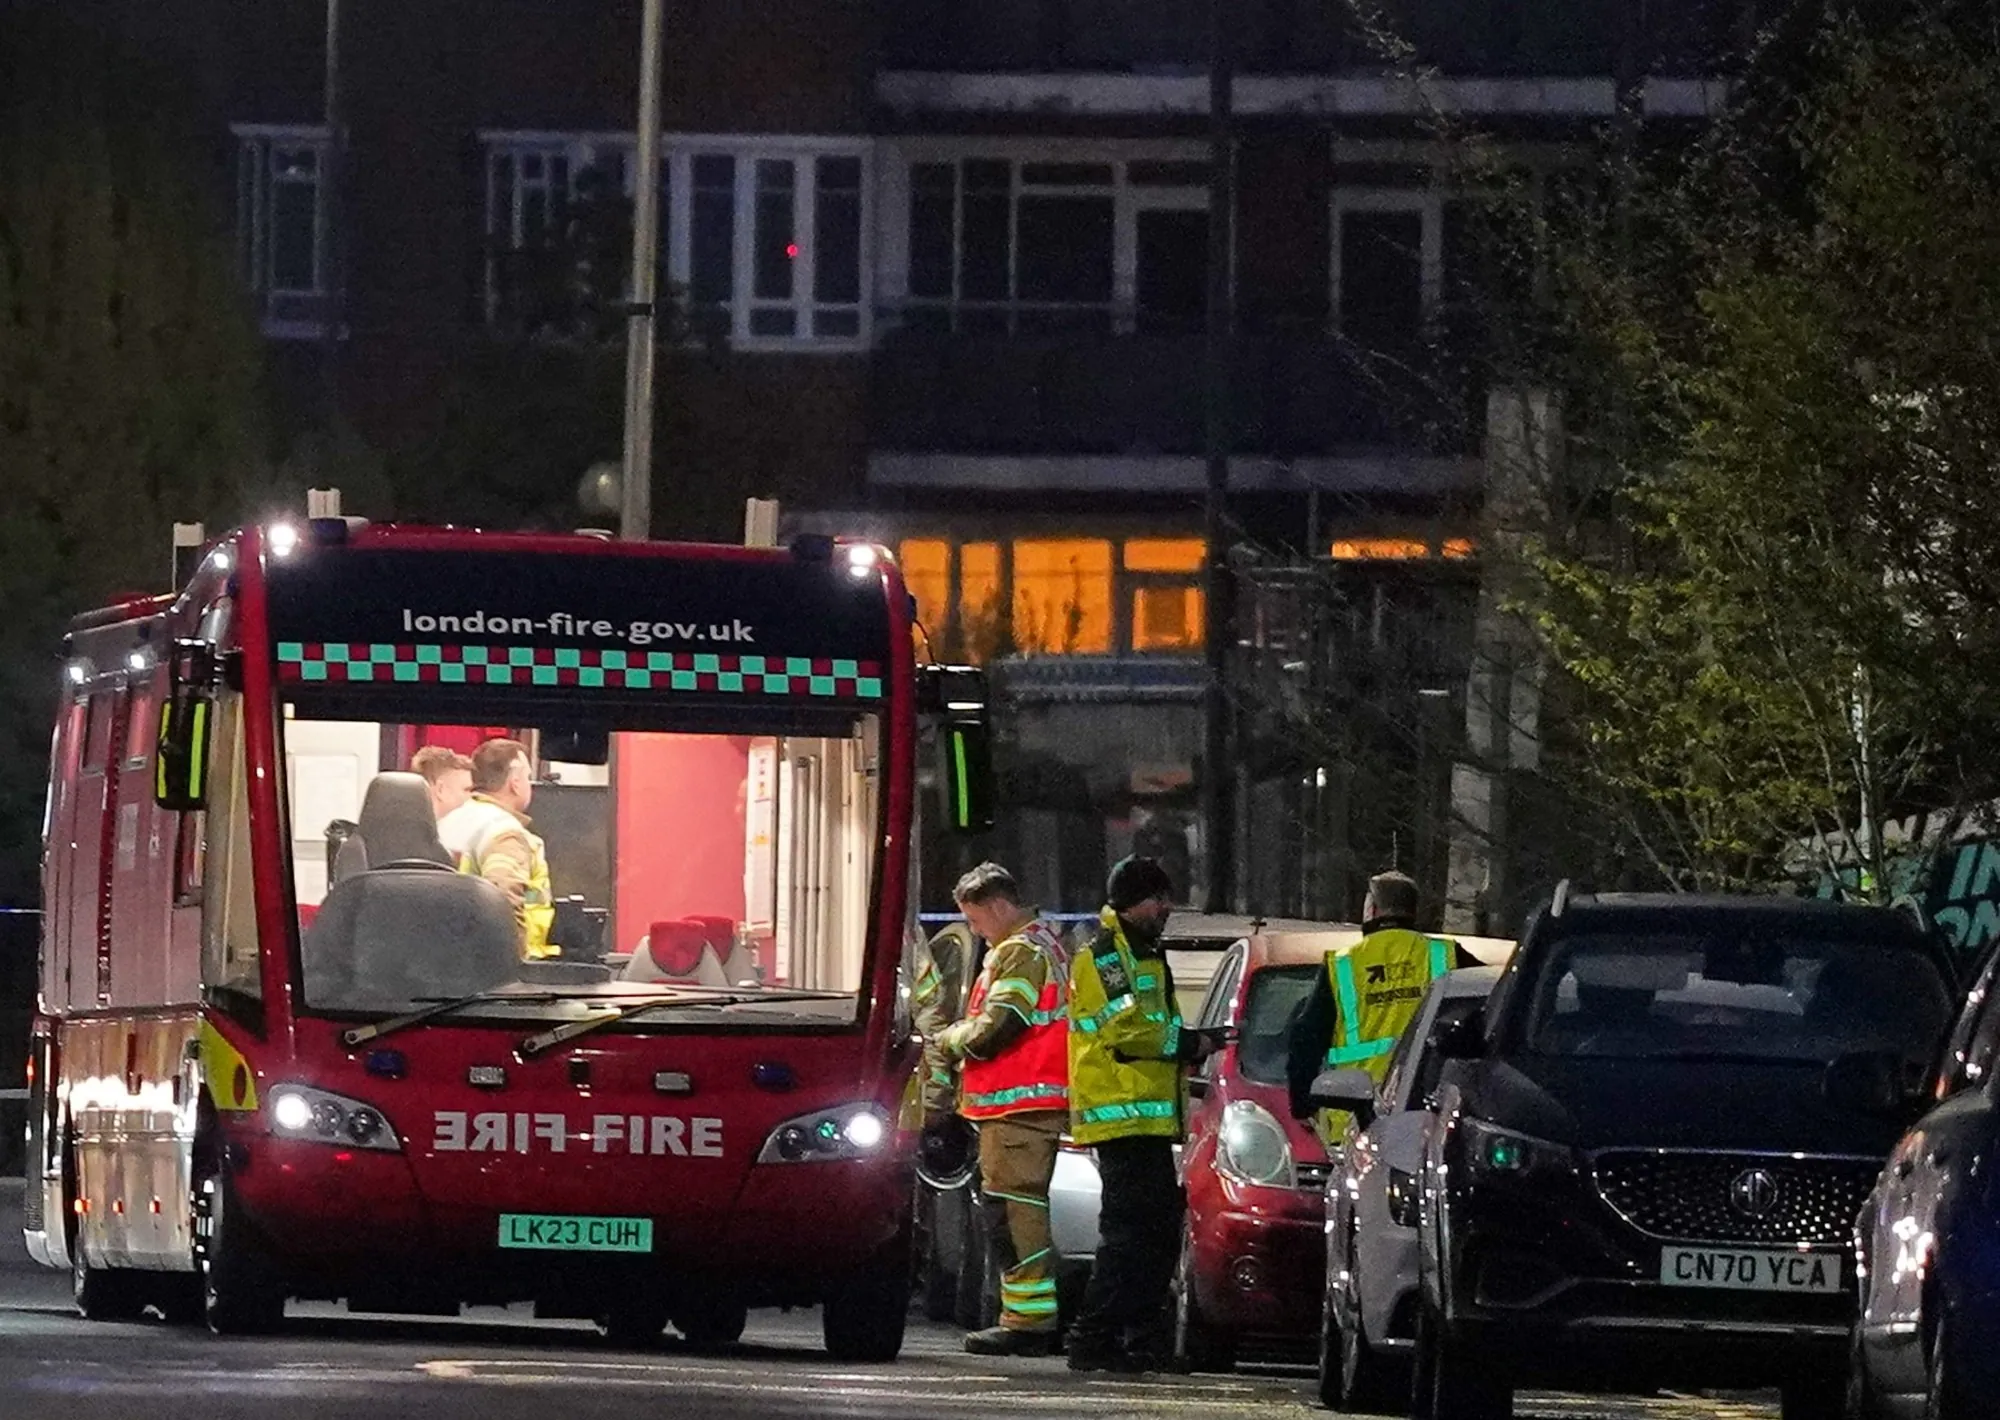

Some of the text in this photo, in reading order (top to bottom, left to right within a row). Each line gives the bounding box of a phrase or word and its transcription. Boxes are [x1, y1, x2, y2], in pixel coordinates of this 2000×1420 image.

[403, 608, 755, 645] london-fire.gov.uk
[592, 1114, 724, 1157] FIRE
[510, 1218, 641, 1246] LK23 CUH
[1675, 1252, 1827, 1288] CN70 YCA
